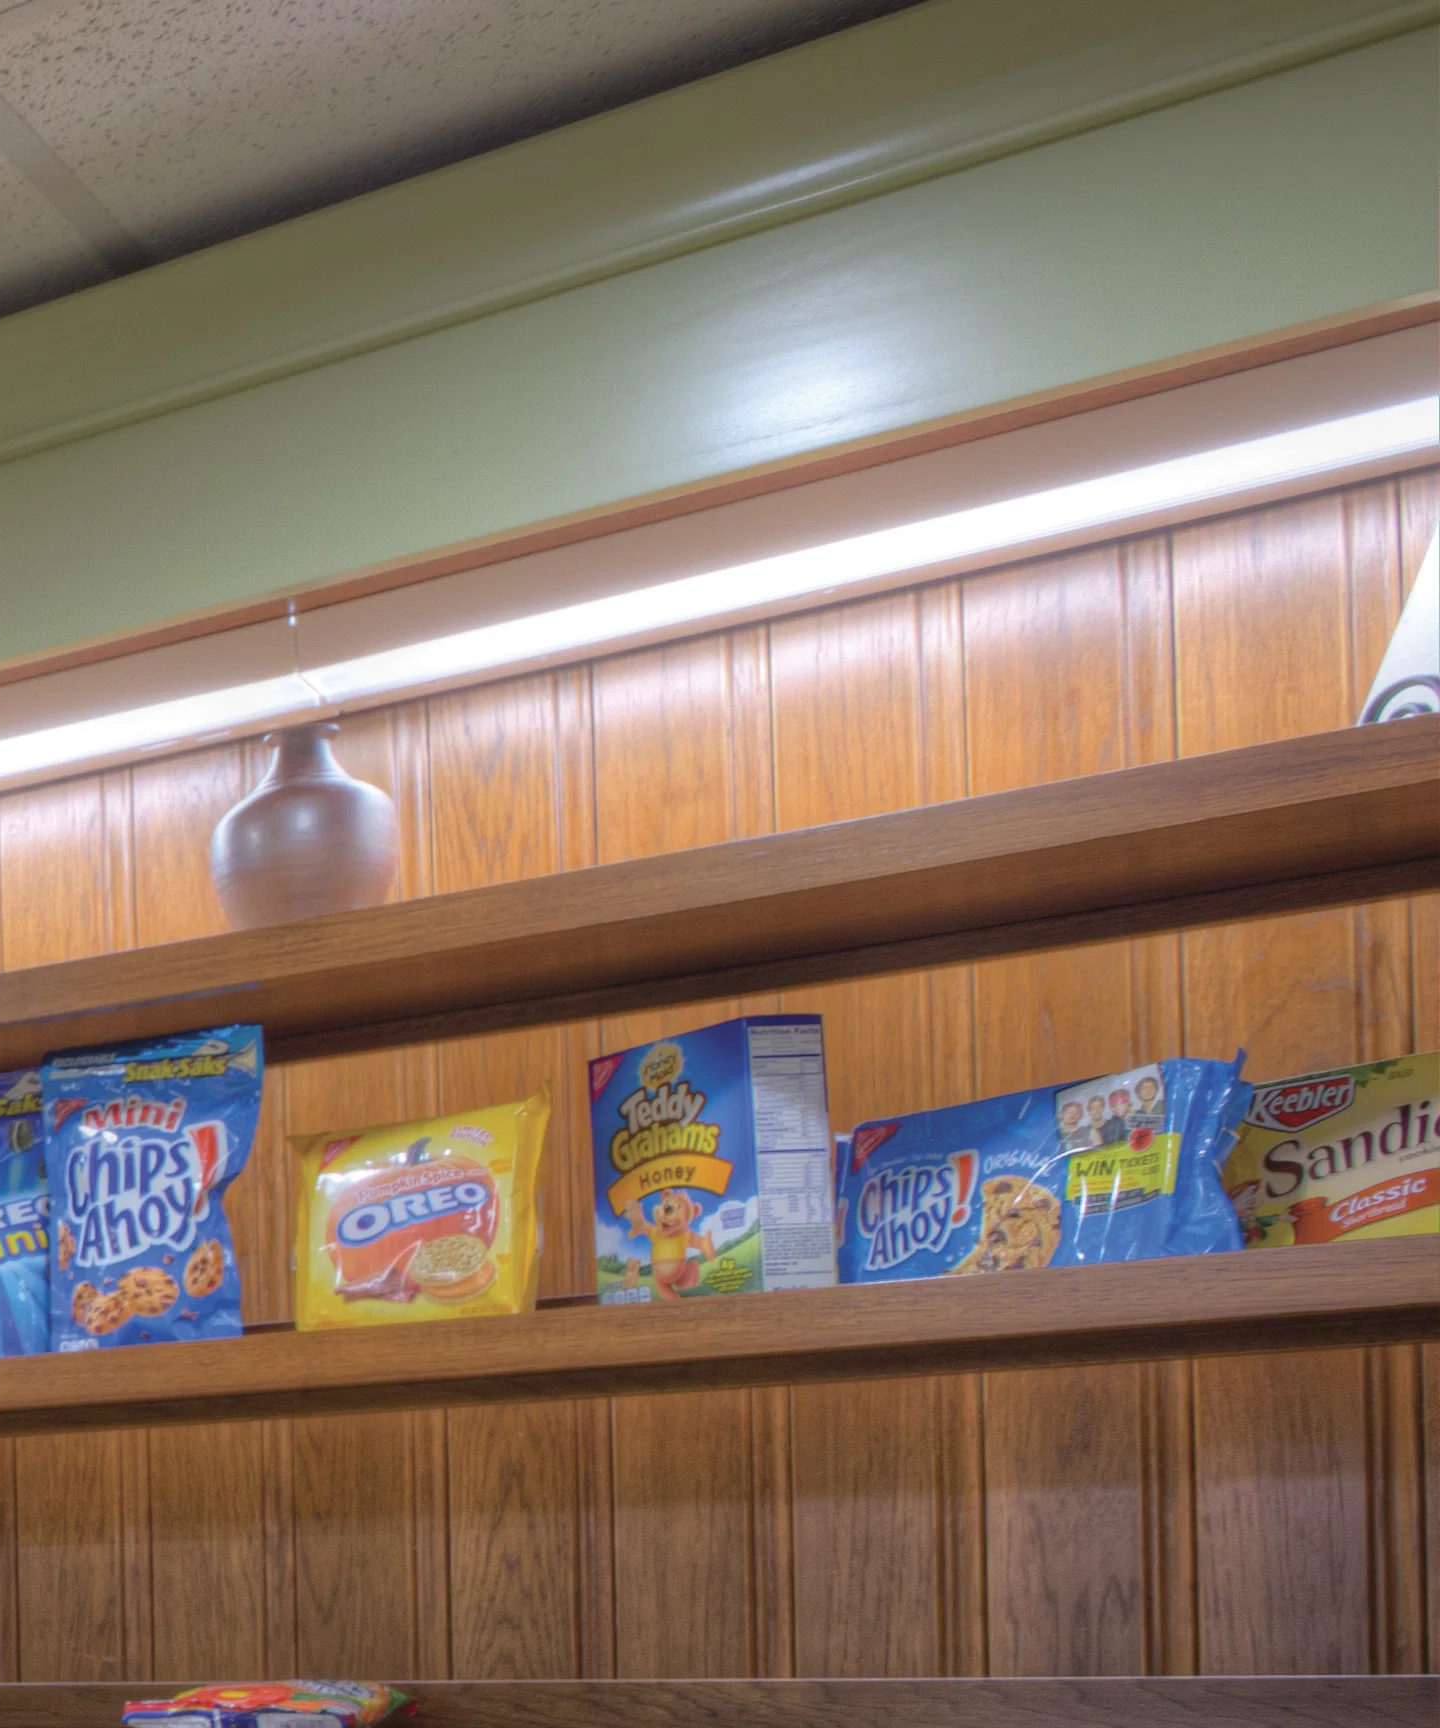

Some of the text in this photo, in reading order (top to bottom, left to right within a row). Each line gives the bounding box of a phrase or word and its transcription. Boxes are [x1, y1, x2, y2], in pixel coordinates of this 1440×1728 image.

[83, 1098, 184, 1131] Mini
[618, 1081, 707, 1133] Teddy
[1249, 1083, 1353, 1125] Keebler
[610, 1121, 721, 1172] Grahams
[1076, 1152, 1160, 1177] WIN TICKETS
[68, 1137, 191, 1217] Chips
[358, 1168, 465, 1201] Pumpkin Spice
[638, 1163, 696, 1190] Honey
[860, 1165, 954, 1233] Chips
[338, 1182, 489, 1246] OREO
[1330, 1177, 1427, 1222] Classic
